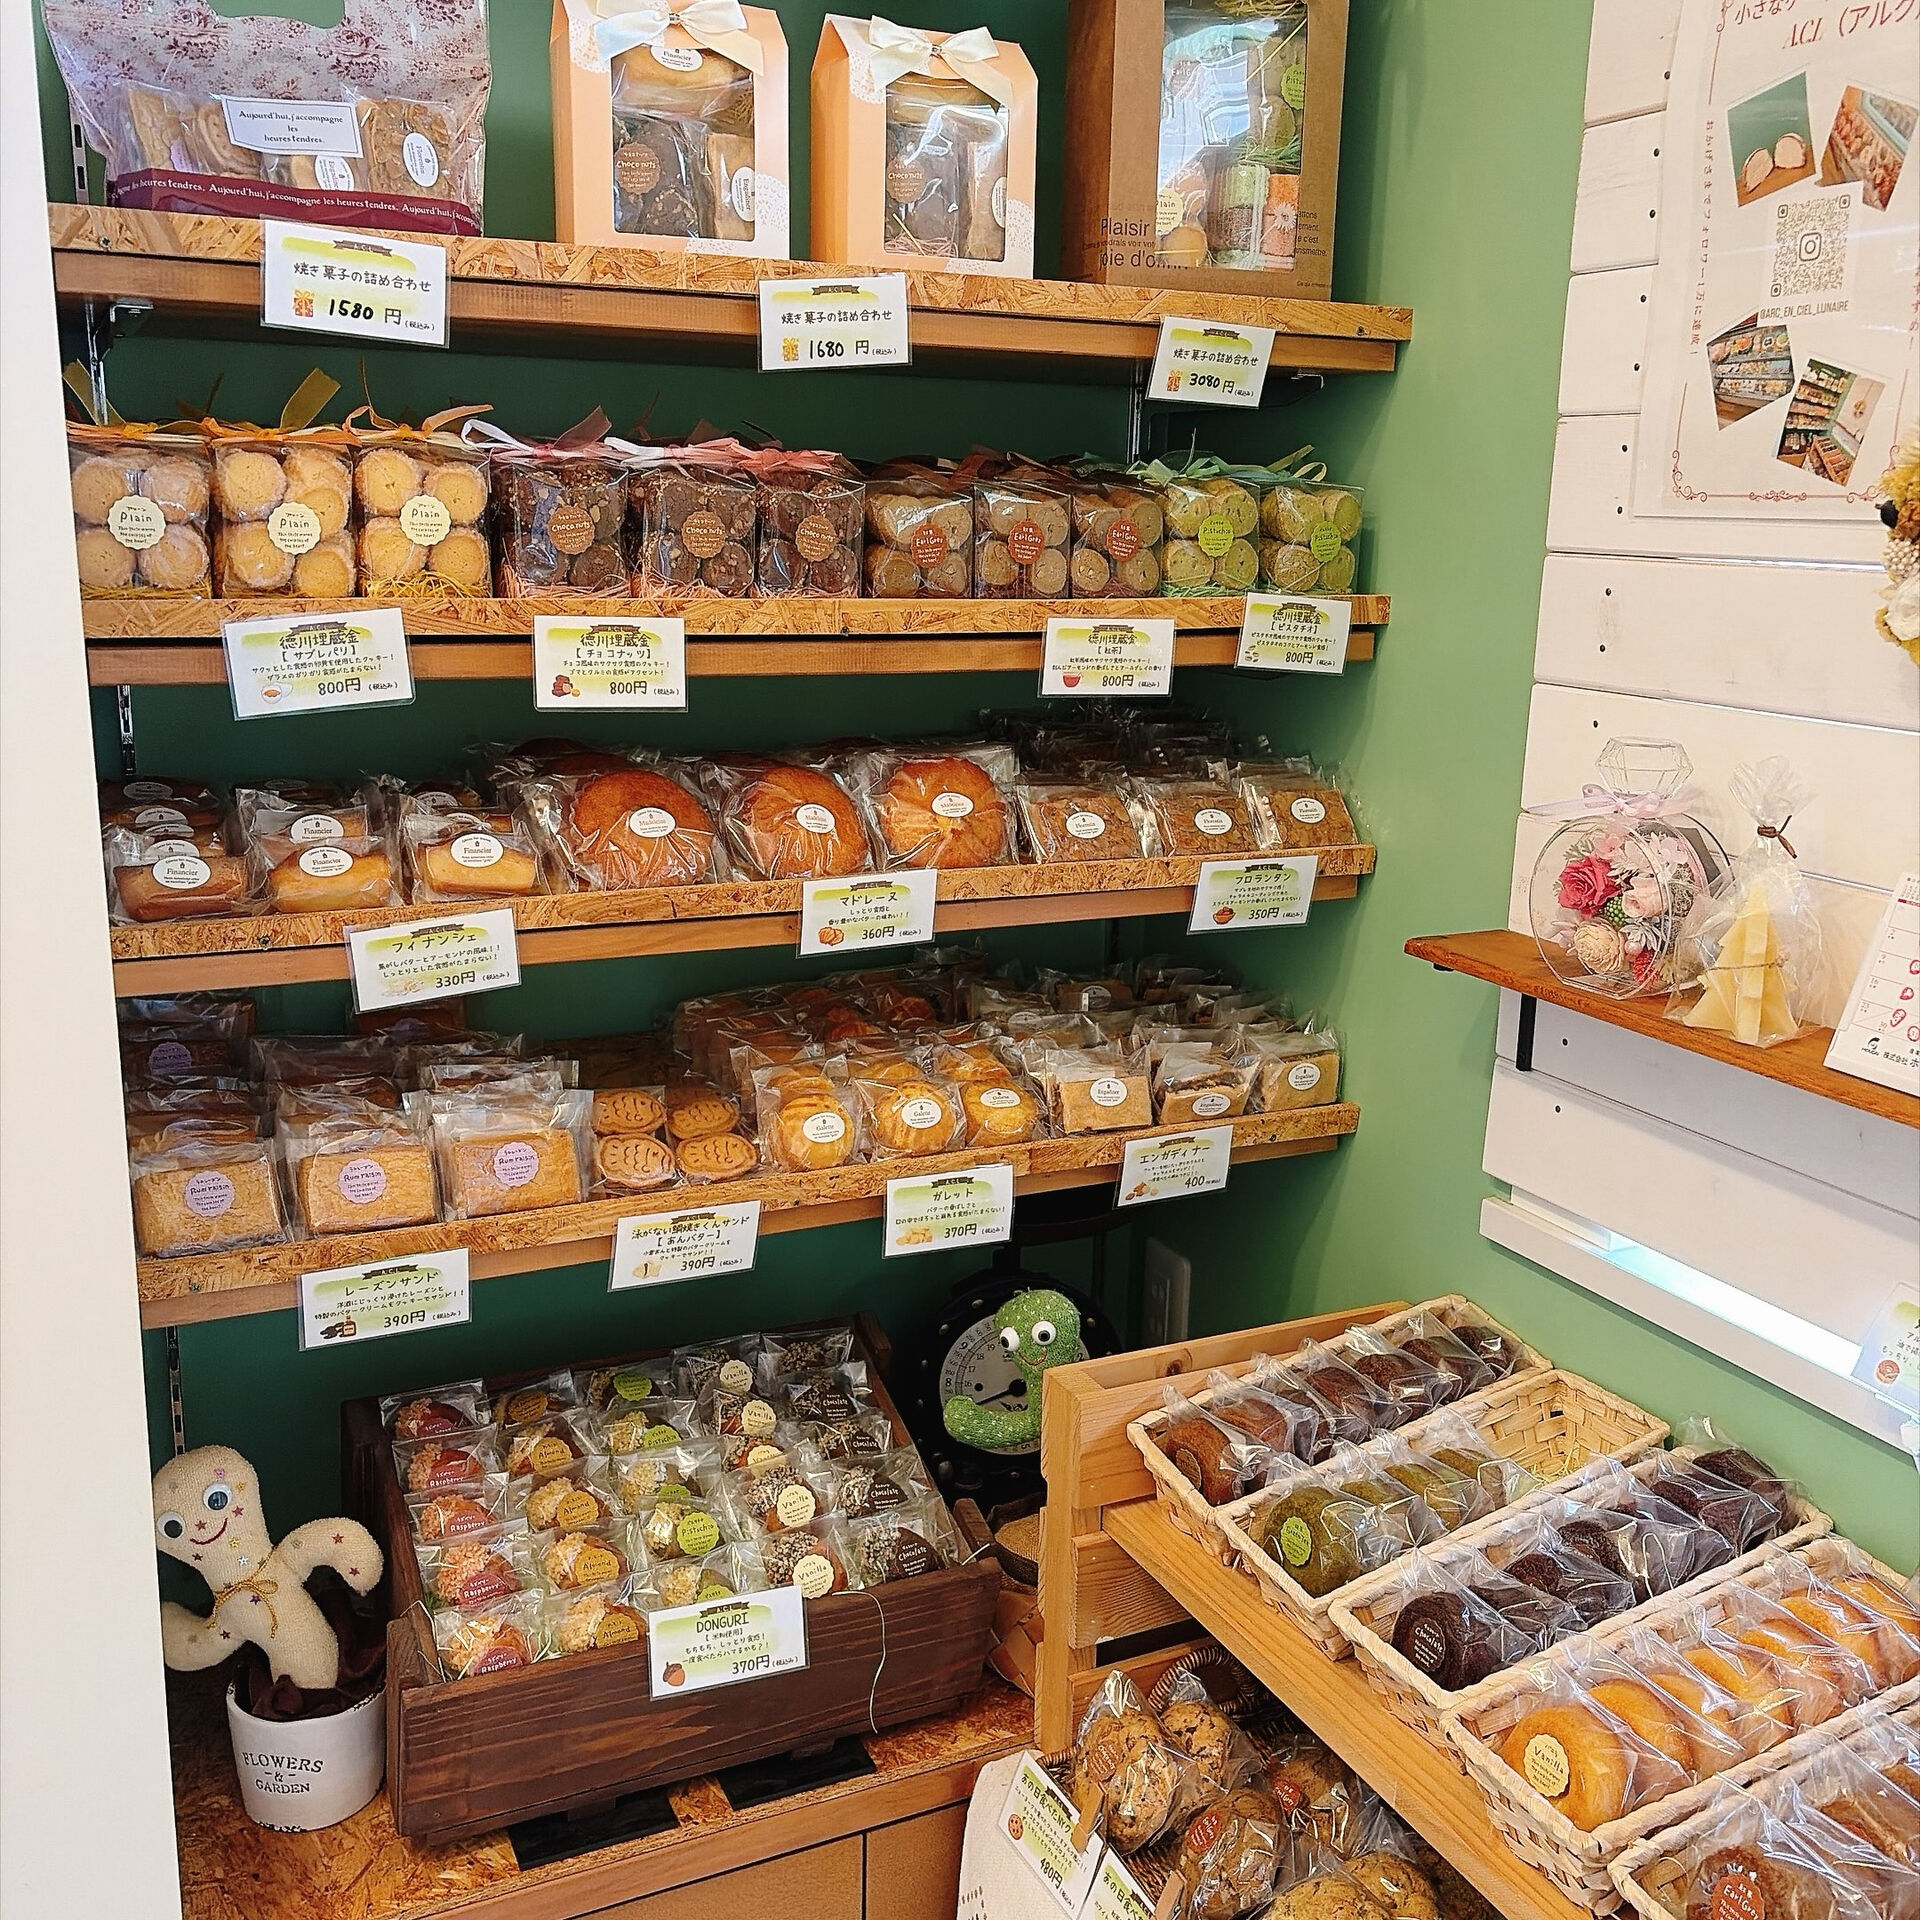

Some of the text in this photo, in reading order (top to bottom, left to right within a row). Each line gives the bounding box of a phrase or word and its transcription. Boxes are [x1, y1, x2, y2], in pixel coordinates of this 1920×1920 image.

[264, 134, 291, 142] heures
[323, 196, 335, 205] les
[336, 197, 364, 208] heures
[365, 200, 399, 212] tendres.
[1101, 218, 1150, 236] Plaisir
[1099, 249, 1124, 270] joie
[293, 262, 432, 292] 焼き菓子の詰め合わせ
[329, 298, 374, 320] 1580
[384, 307, 402, 325] 円
[781, 309, 893, 325] 焼き菓子の詰め合わせ
[809, 340, 844, 359] 1680
[855, 340, 869, 355] 円
[1173, 348, 1259, 367] 焼き菓子の詰め合わせ
[1189, 373, 1220, 388] 3080
[1222, 380, 1235, 394] 円
[120, 511, 152, 522] Plain
[412, 508, 440, 518] Plain
[280, 518, 309, 528] Plain
[279, 629, 361, 650] 徳川埋蔵金
[580, 633, 652, 648] 徳川埋蔵金
[576, 649, 651, 659] 【チョコナッツ】
[1285, 651, 1314, 665] 800円
[318, 677, 361, 696] 800円
[609, 680, 648, 695] 800円
[1102, 674, 1134, 687] 800円
[304, 826, 333, 836] Financier
[463, 845, 492, 855] Financier
[312, 858, 342, 866] Financier
[167, 867, 198, 877] Financier
[1235, 873, 1291, 885] フロランタン
[840, 892, 898, 906] マドレーヌ
[1249, 907, 1279, 920] 350円
[862, 926, 895, 940] 360円
[392, 933, 477, 953] フィナンシェ
[436, 970, 476, 988] 330円
[1140, 1146, 1210, 1164] エンガディナー
[344, 1174, 361, 1182] Rum
[1184, 1175, 1206, 1189] 400
[190, 1186, 208, 1195] Rum
[933, 1188, 973, 1201] ガレット
[944, 1223, 977, 1238] 370円
[681, 1256, 715, 1271] 390円
[345, 1271, 439, 1297] レーズンサンド
[384, 1310, 426, 1328] 390円
[450, 1520, 486, 1533] Raspberry
[696, 1612, 750, 1633] DONGURI
[1415, 1627, 1444, 1653] Chocolate
[732, 1654, 770, 1675] 370円
[242, 1752, 324, 1773] FLOWERS
[1534, 1748, 1564, 1775] Vanilla
[255, 1779, 310, 1794] GARDEN
[1039, 1857, 1064, 1890] 480円
